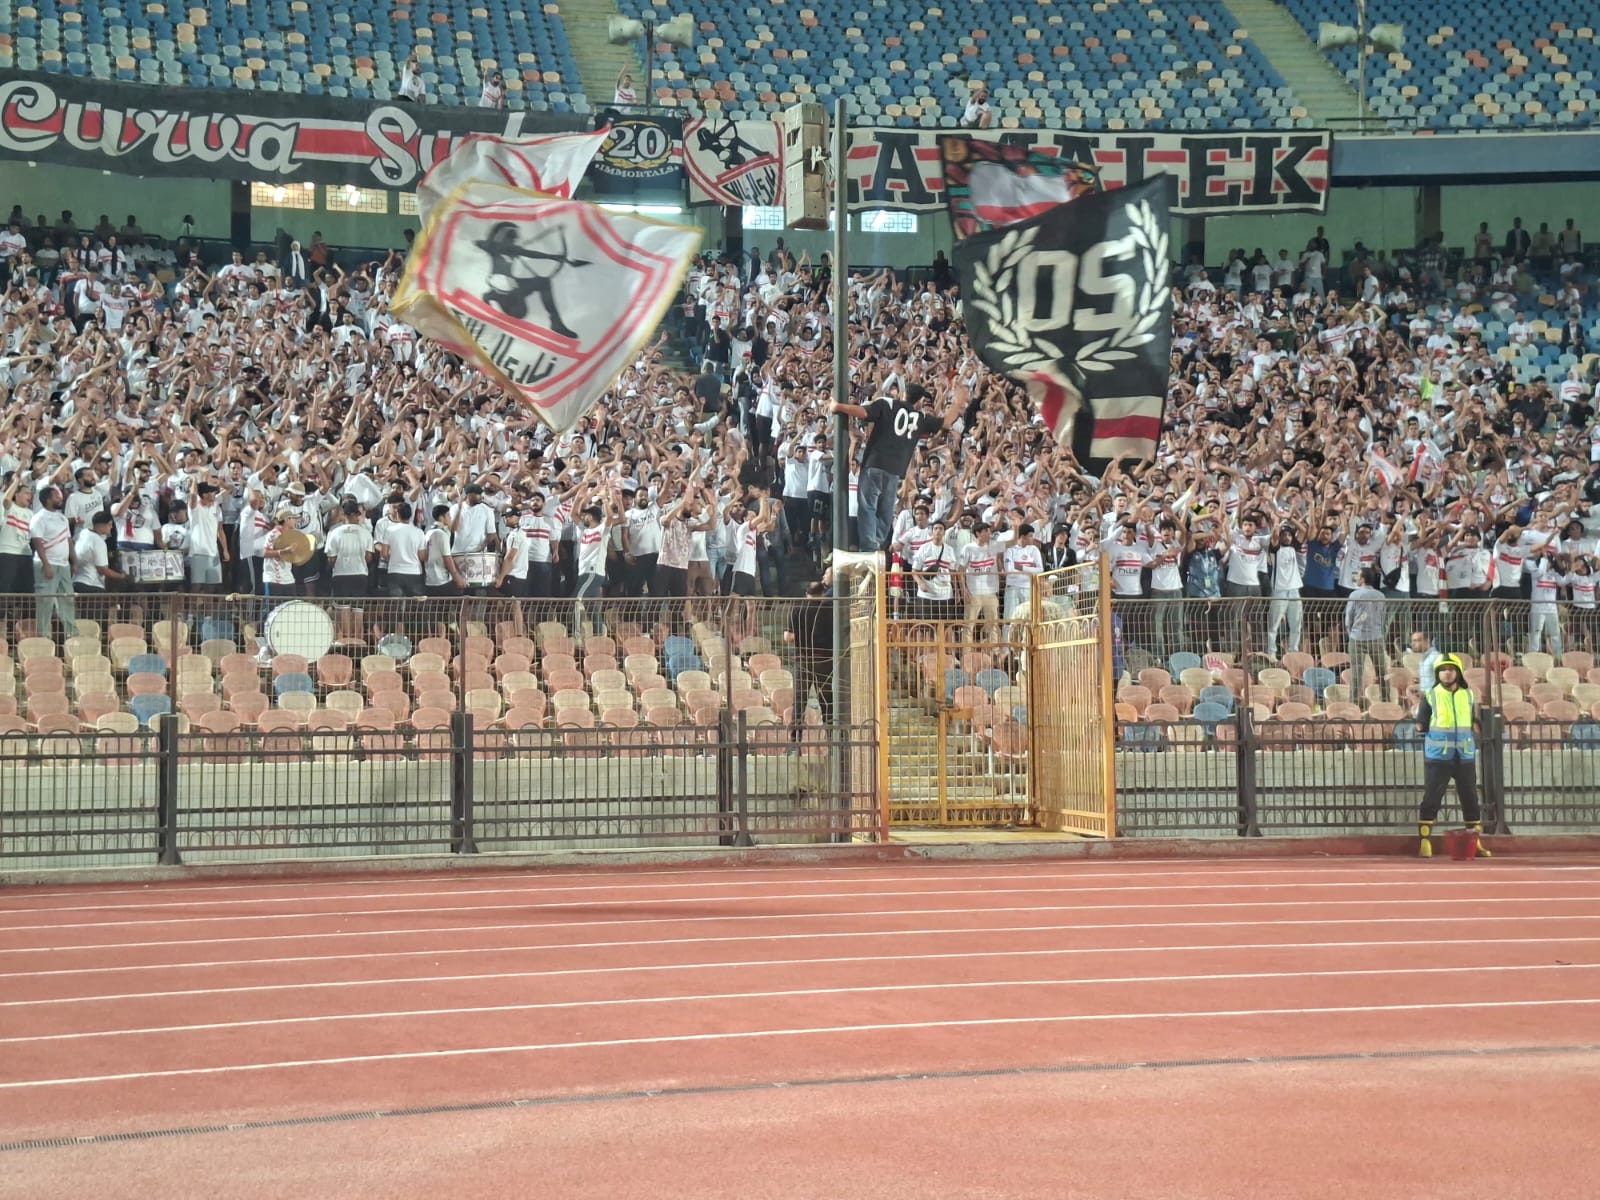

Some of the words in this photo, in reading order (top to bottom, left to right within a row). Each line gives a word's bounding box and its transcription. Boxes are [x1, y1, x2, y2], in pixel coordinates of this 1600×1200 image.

[0, 80, 303, 174] Curva
[364, 106, 525, 187] Su
[608, 127, 666, 159] 20
[600, 163, 674, 178] IMMORTALS
[893, 407, 919, 440] 07
